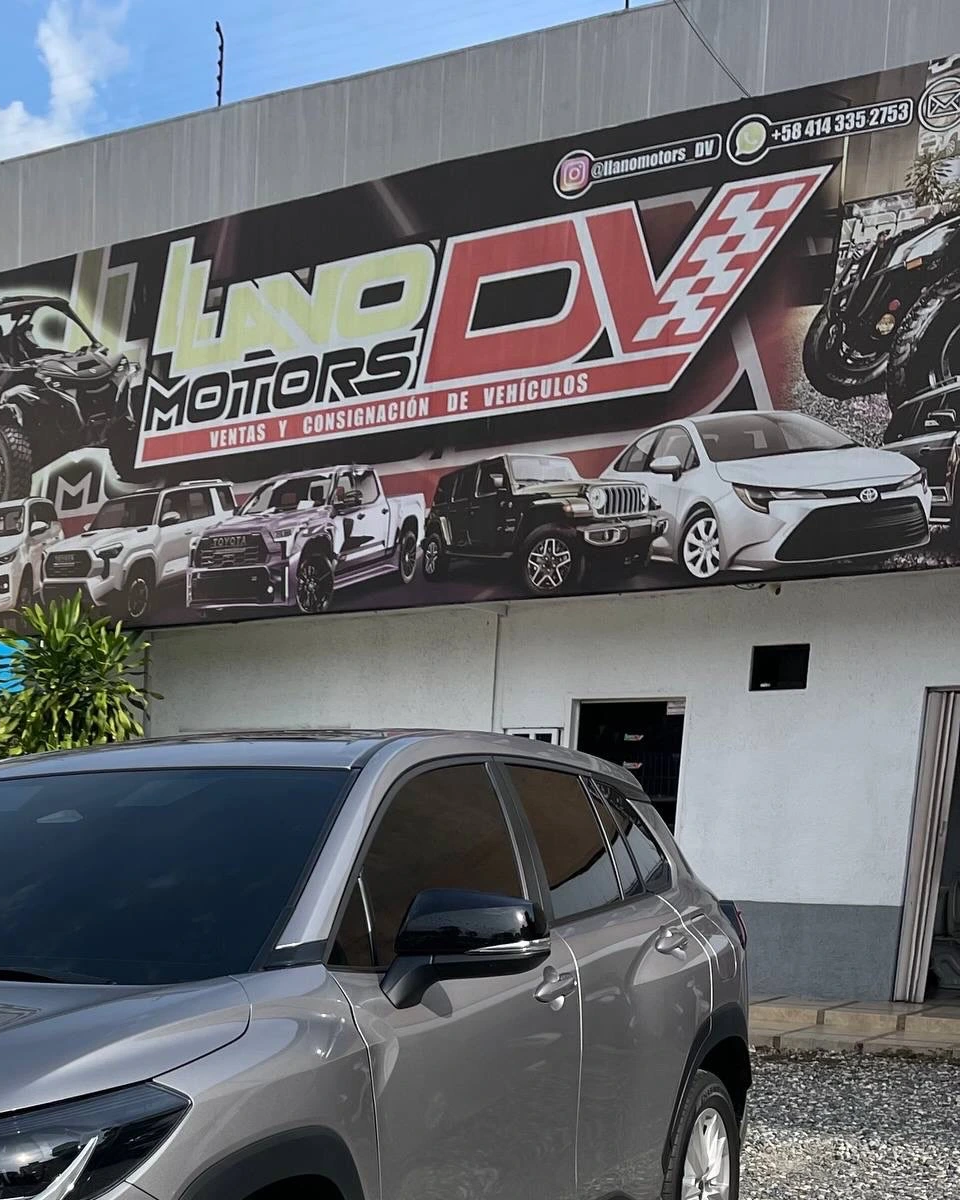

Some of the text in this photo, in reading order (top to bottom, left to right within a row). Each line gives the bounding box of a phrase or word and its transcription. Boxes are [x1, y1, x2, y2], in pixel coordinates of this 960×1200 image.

[771, 123, 802, 144] +58
[805, 115, 832, 138] 414
[869, 102, 909, 126] 2753
[591, 143, 715, 179] @llanomotors_DV
[426, 165, 833, 384] DV
[143, 336, 420, 433] MOTORS
[209, 372, 589, 448] VENTAS Y CONSIGNACIÓN DE VEHÍCULOS
[212, 535, 247, 547] TOYOTA
